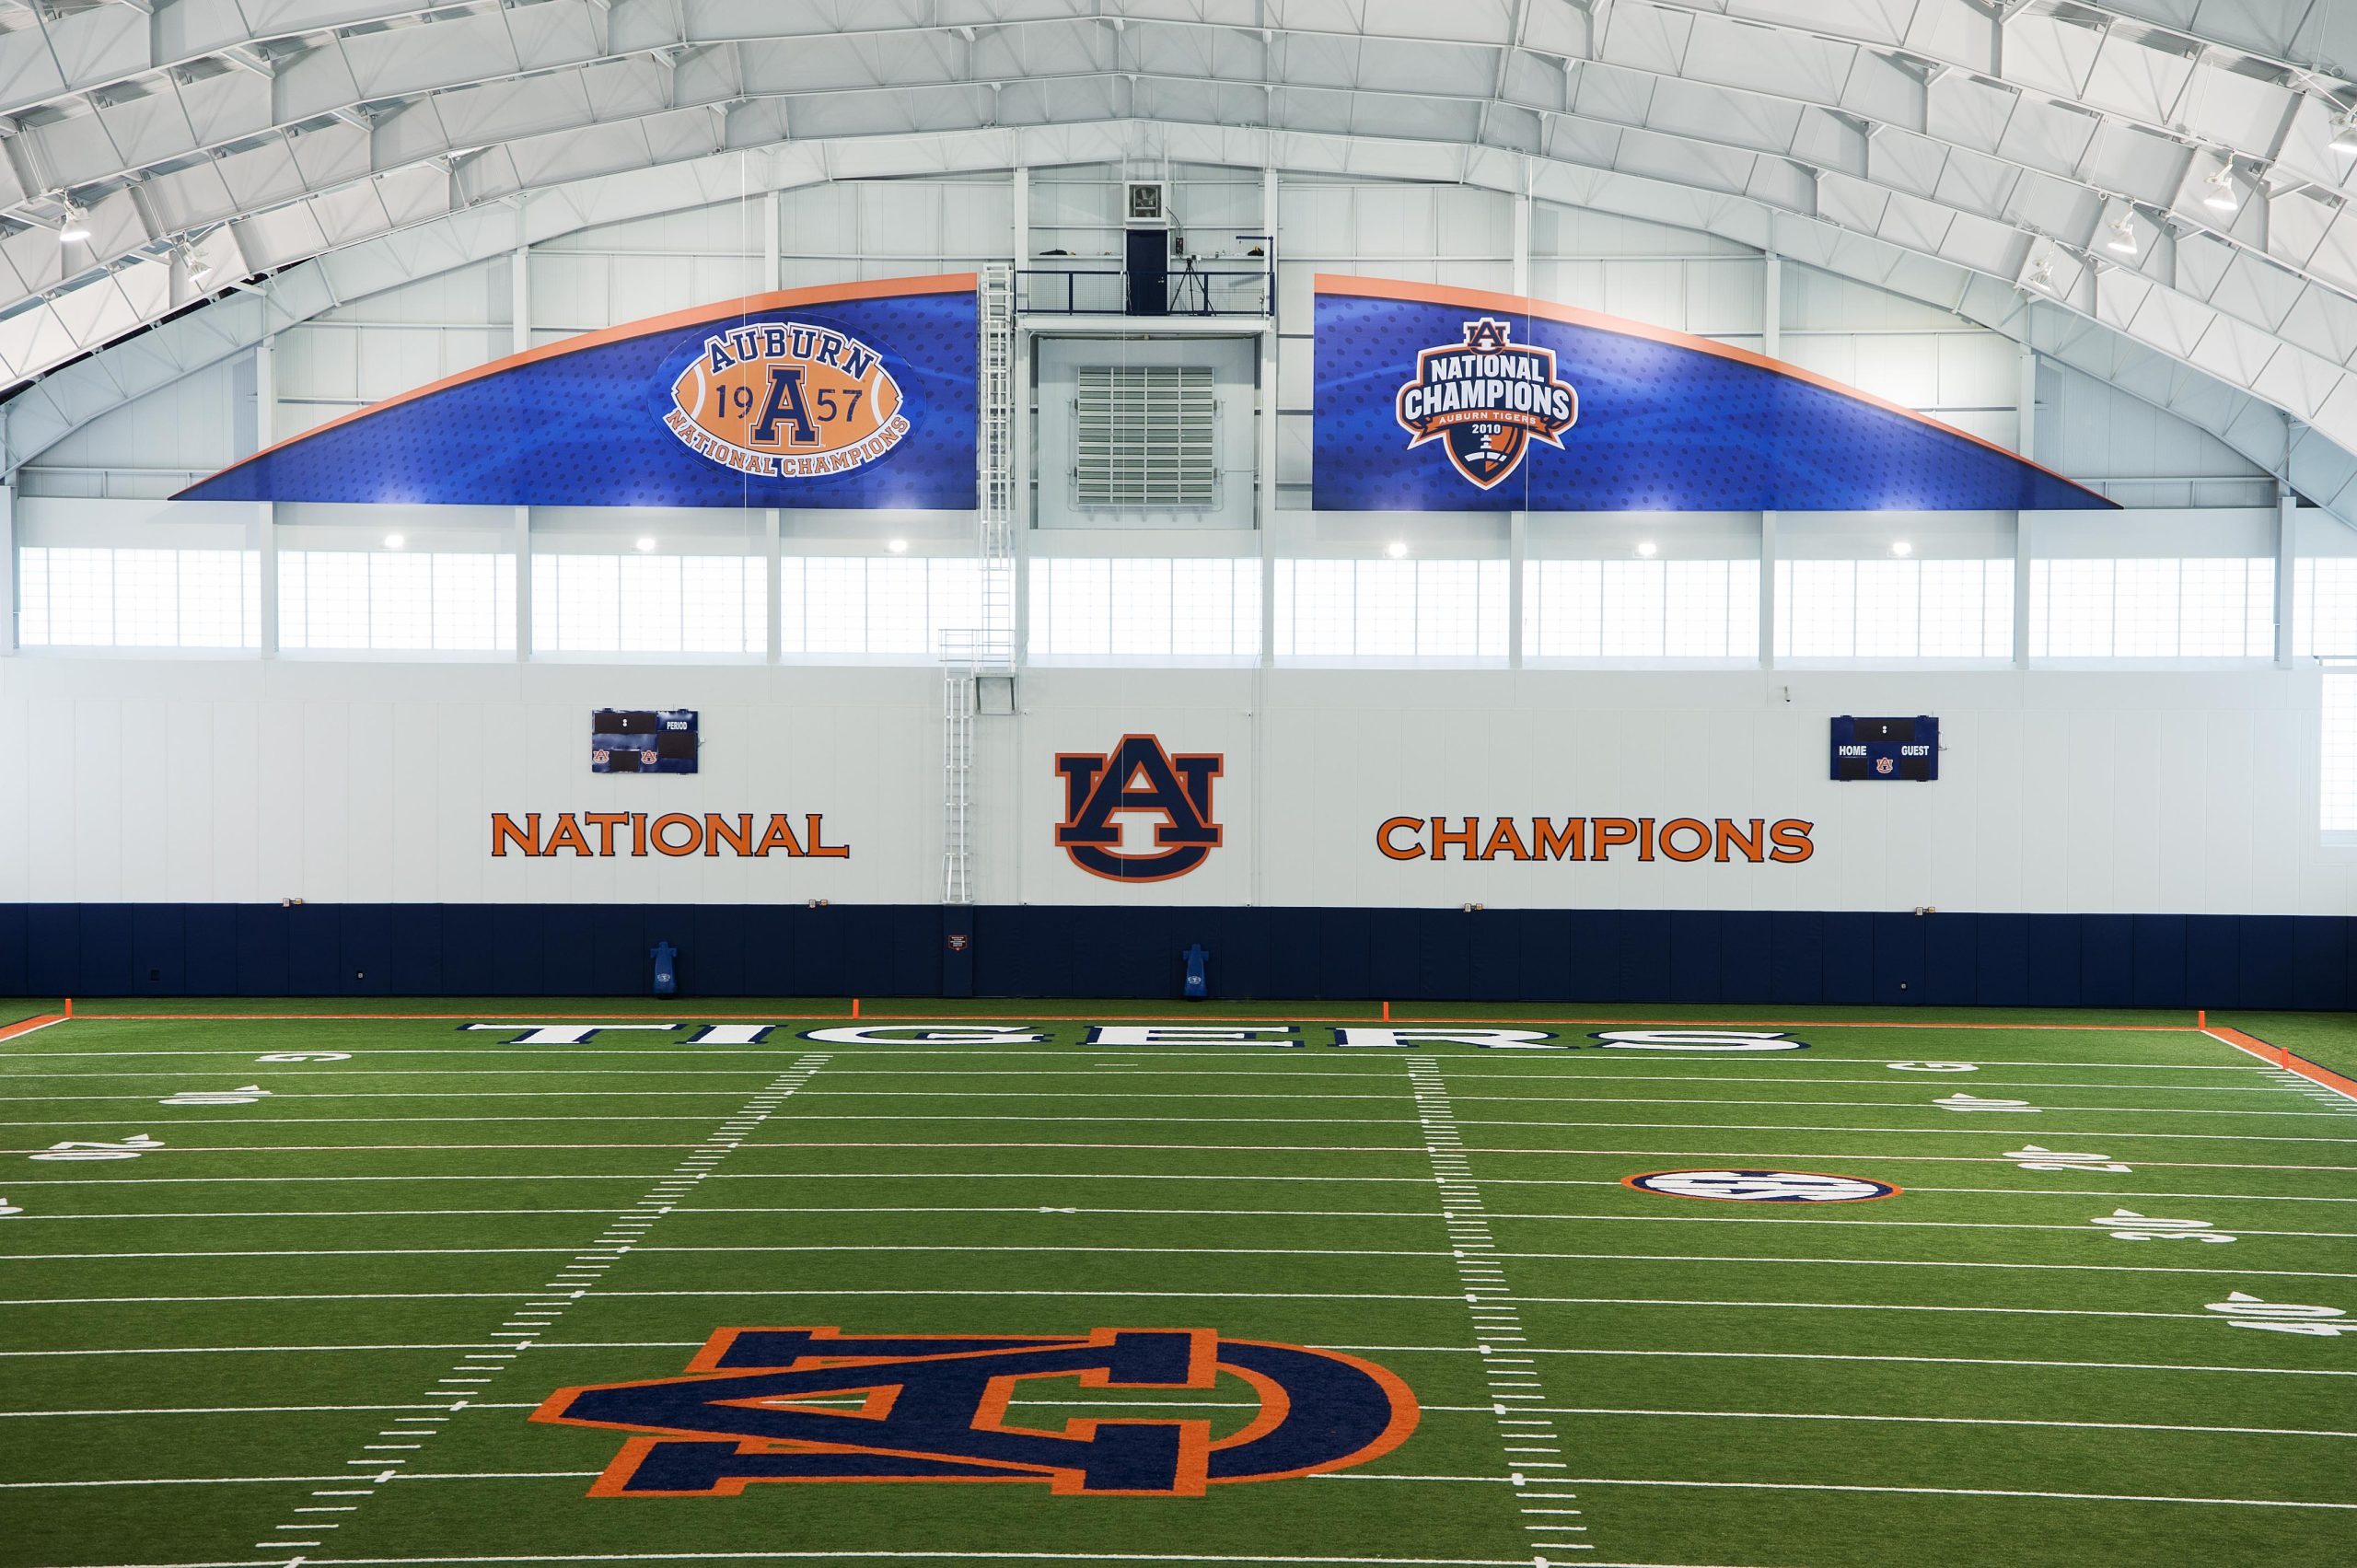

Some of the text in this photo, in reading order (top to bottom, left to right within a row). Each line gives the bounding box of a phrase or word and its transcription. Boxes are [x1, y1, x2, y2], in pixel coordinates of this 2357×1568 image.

[708, 326, 876, 381] AUBURN
[1431, 354, 1544, 382] NATIONAL
[1405, 379, 1569, 420] CHAMPIONS
[1439, 412, 1537, 424] AUBURN TIGERS
[1472, 424, 1502, 434] 2010
[667, 410, 910, 475] NATIONAL CHAMPIONS
[667, 721, 688, 730] PERIOD
[1839, 745, 1867, 756] HOME
[1901, 745, 1930, 756] GUEST
[491, 811, 850, 858] NATIONAL
[1376, 816, 1815, 864] CHAMPIONS
[455, 1022, 1812, 1051] TIGERS
